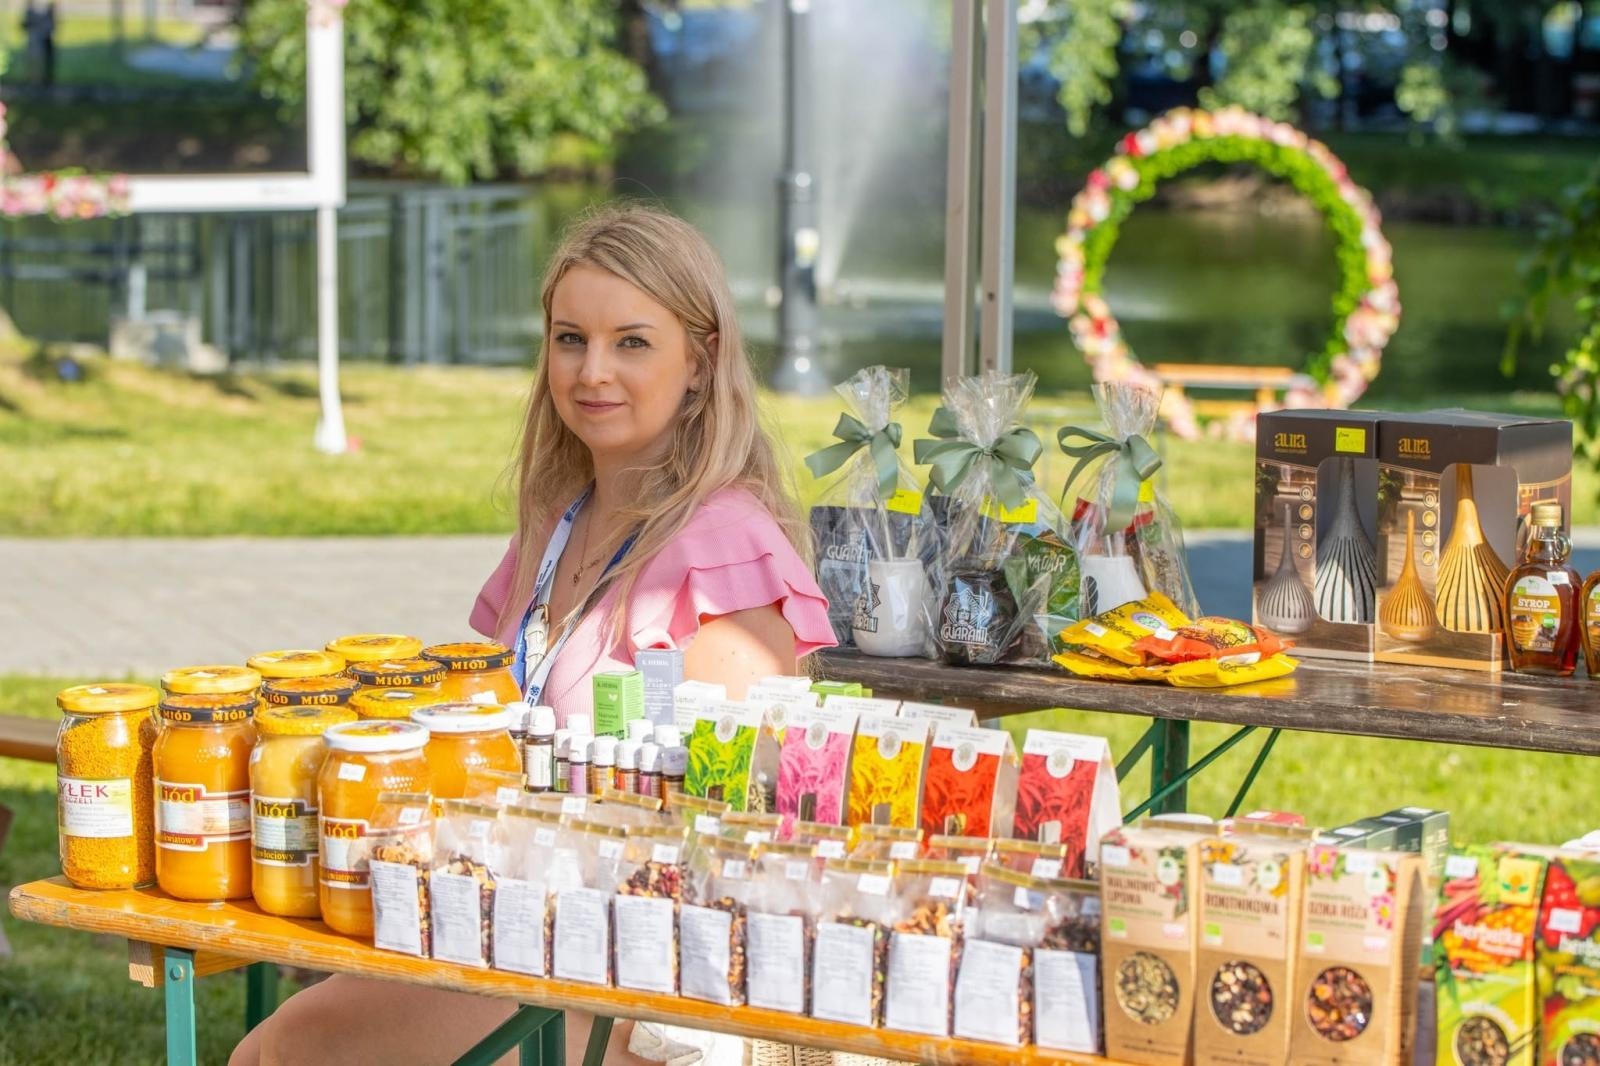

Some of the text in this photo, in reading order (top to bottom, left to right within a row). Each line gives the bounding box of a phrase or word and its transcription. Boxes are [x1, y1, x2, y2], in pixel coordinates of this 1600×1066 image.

[1517, 597, 1551, 609] SYROP
[451, 659, 488, 670] MIÓD
[375, 673, 412, 686] MIÓD
[301, 692, 338, 706] MIÓD
[212, 708, 247, 721] MIÓD
[58, 782, 109, 798] YŁEK
[163, 786, 195, 804] iód
[327, 822, 358, 840] iód
